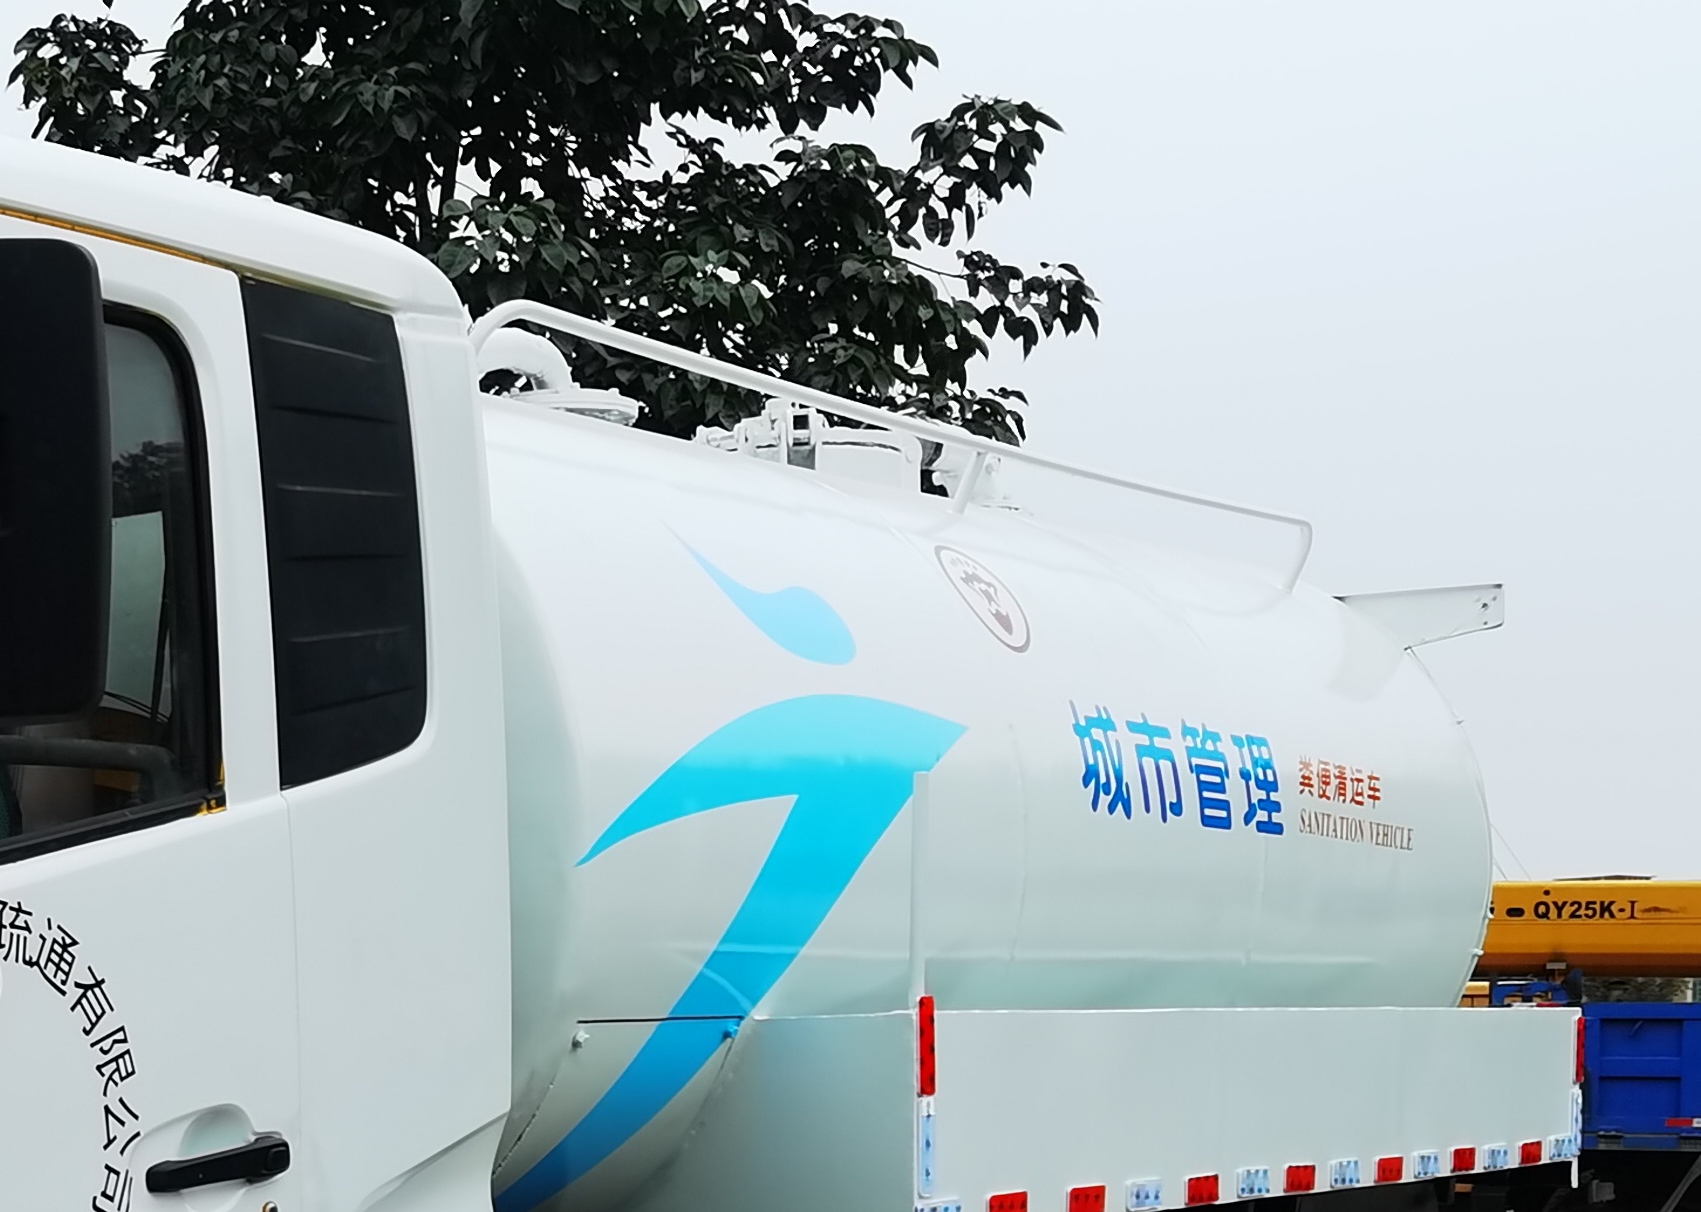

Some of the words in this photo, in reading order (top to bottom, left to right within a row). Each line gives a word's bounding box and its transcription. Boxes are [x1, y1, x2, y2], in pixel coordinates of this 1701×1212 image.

[1068, 698, 1285, 836] 城市管理
[1298, 754, 1381, 809] 粪便清运车
[1299, 807, 1365, 843] SANITATION
[1369, 821, 1414, 851] VEHICLE
